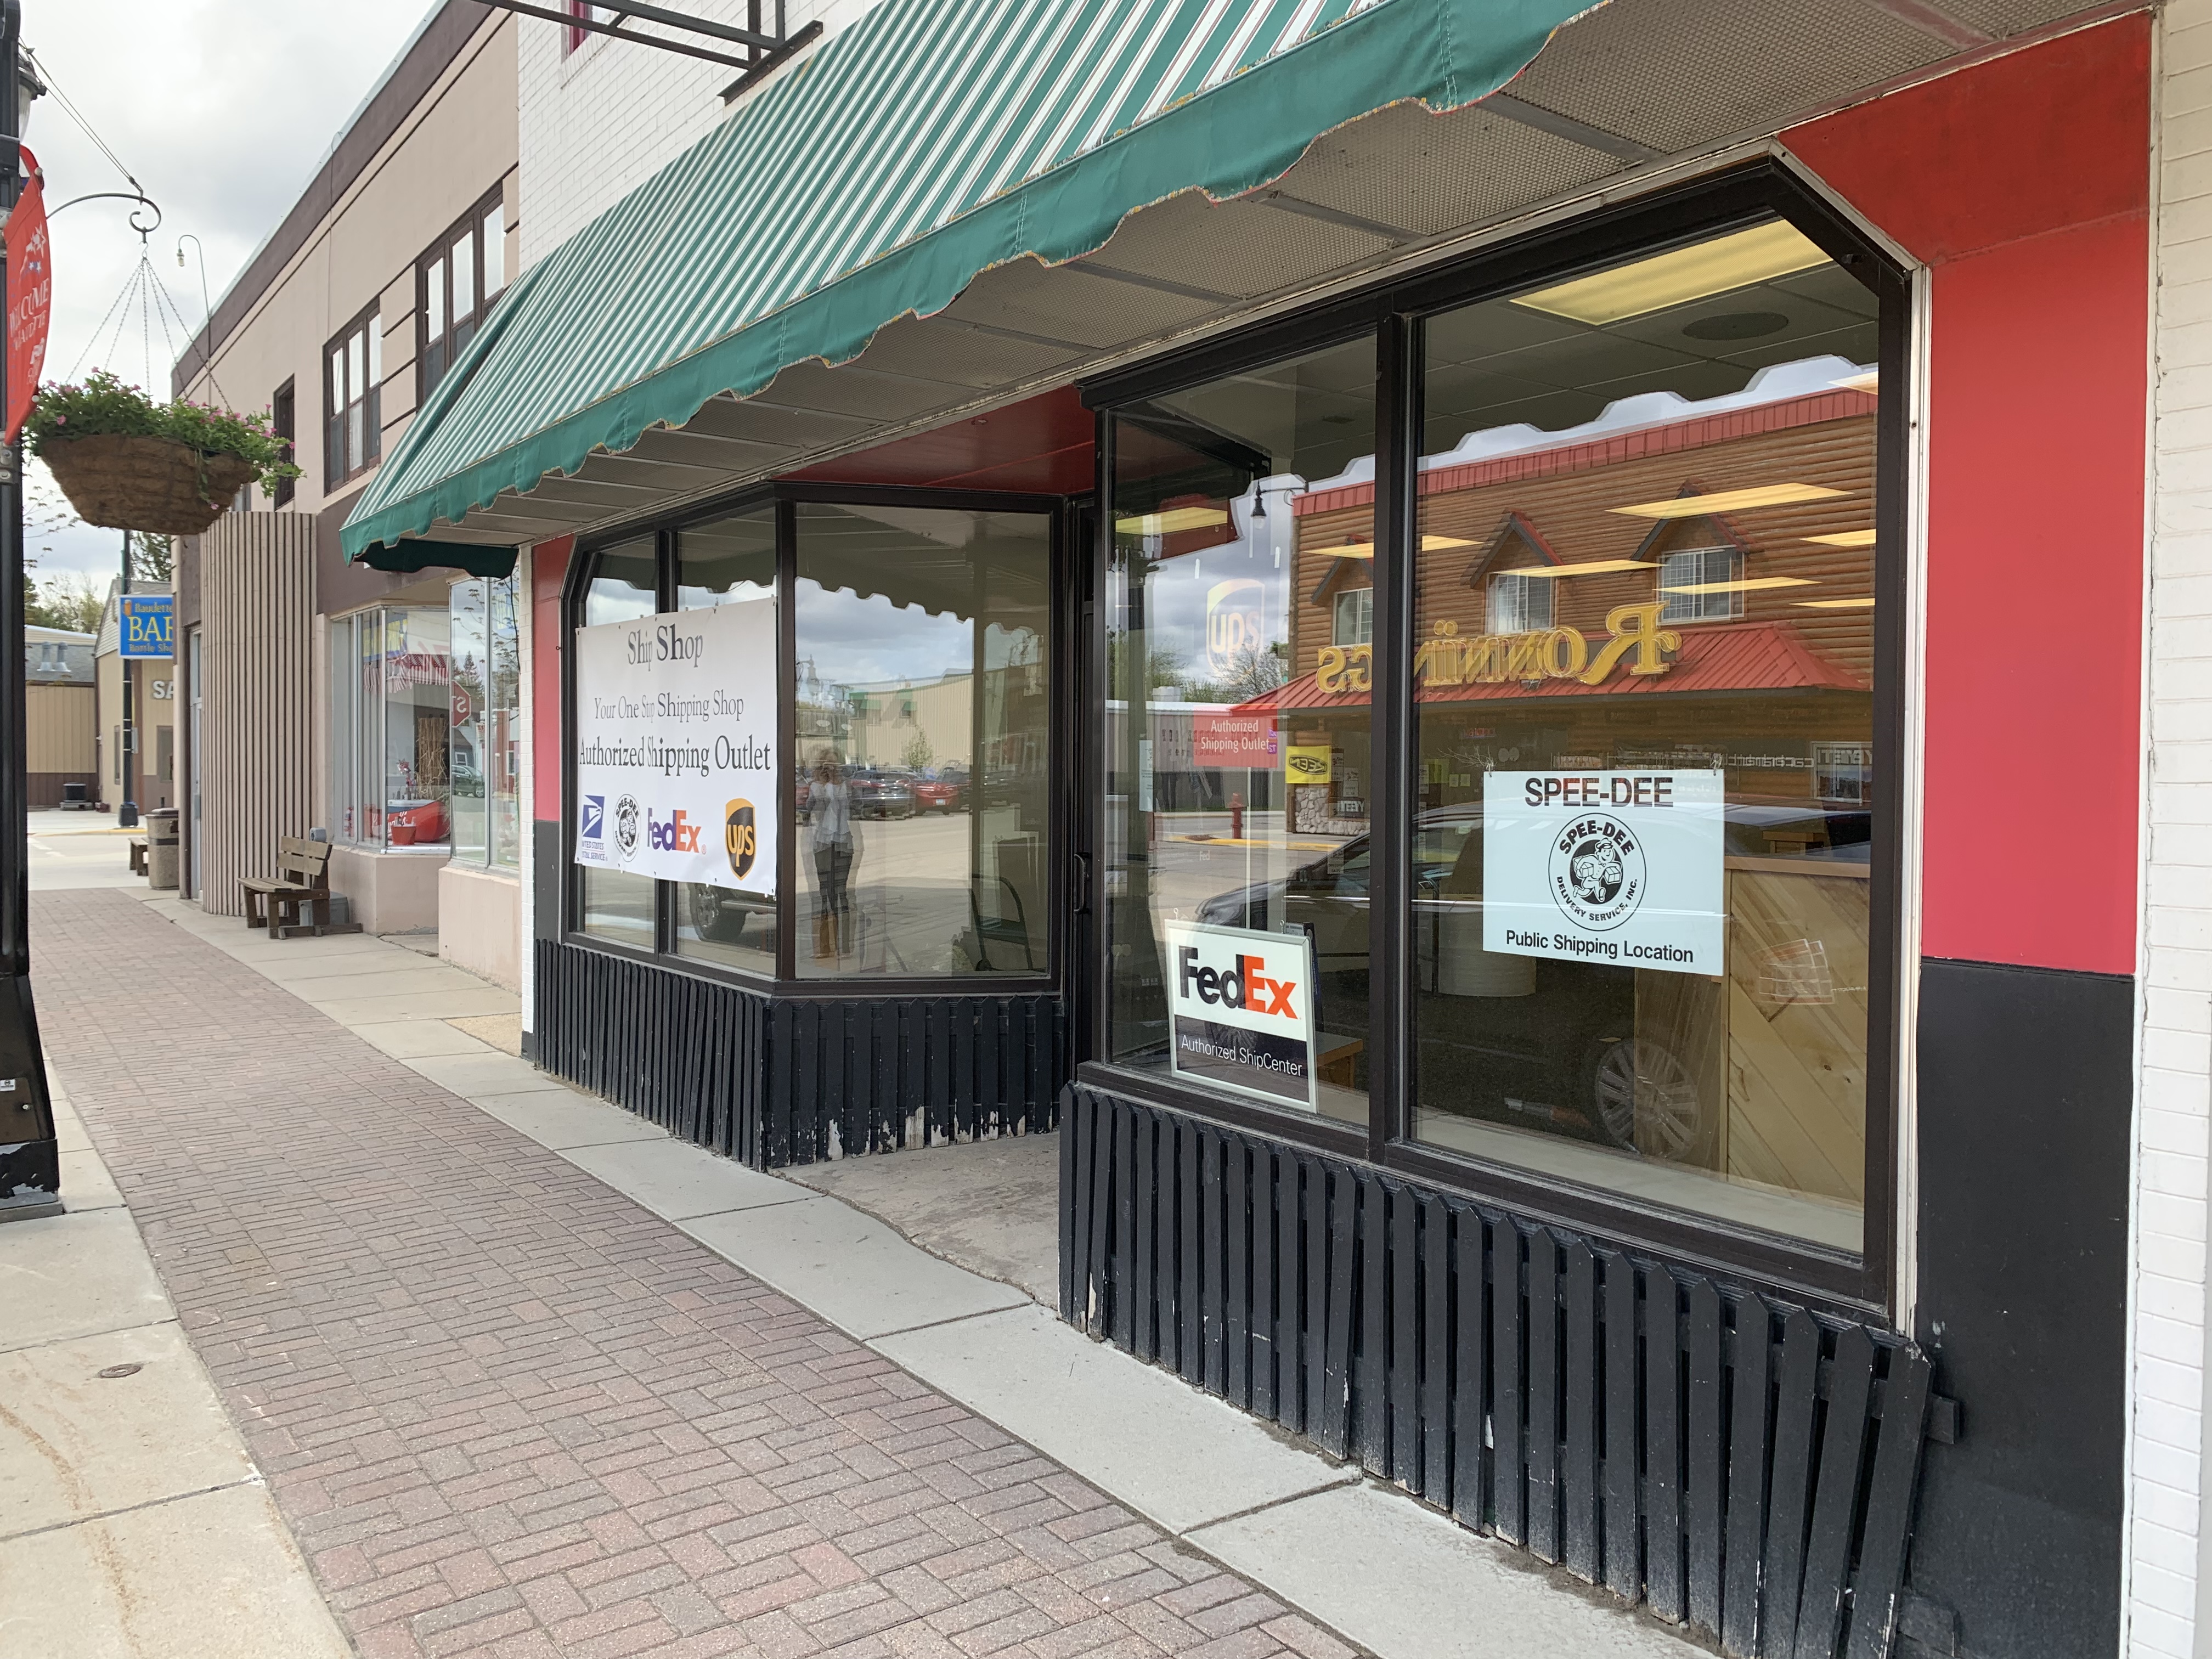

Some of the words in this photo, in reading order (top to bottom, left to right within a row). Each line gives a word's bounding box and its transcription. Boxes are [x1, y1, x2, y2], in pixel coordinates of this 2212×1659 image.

[628, 629, 653, 672] Ship
[657, 623, 703, 668] Shop
[595, 697, 616, 719] Your
[618, 696, 639, 718] One
[657, 692, 709, 723] Shipping
[713, 689, 744, 721] Shop
[1201, 737, 1238, 753] Shipping
[1242, 736, 1270, 750] Outlet
[1211, 719, 1259, 732] Authorized
[579, 735, 644, 766] Authorized
[647, 736, 710, 777] Shipping
[715, 733, 771, 770] Outlet
[616, 797, 639, 819] SPEE-DEE
[1525, 777, 1673, 807] SPEE-DEE
[647, 808, 702, 853] FedEx
[727, 825, 754, 867] ups
[1559, 820, 1634, 856] SPEE-DEE
[1557, 876, 1587, 917] DELIVERY
[1589, 902, 1628, 921] SERVICE,
[1626, 878, 1638, 901] INC.
[1506, 930, 1548, 948] Public
[1554, 934, 1617, 959] Shipping
[1624, 940, 1693, 963] Location
[1178, 945, 1299, 1019] FedEx
[1181, 1035, 1236, 1061] Authorized
[1239, 1047, 1302, 1076] ShipCenter
